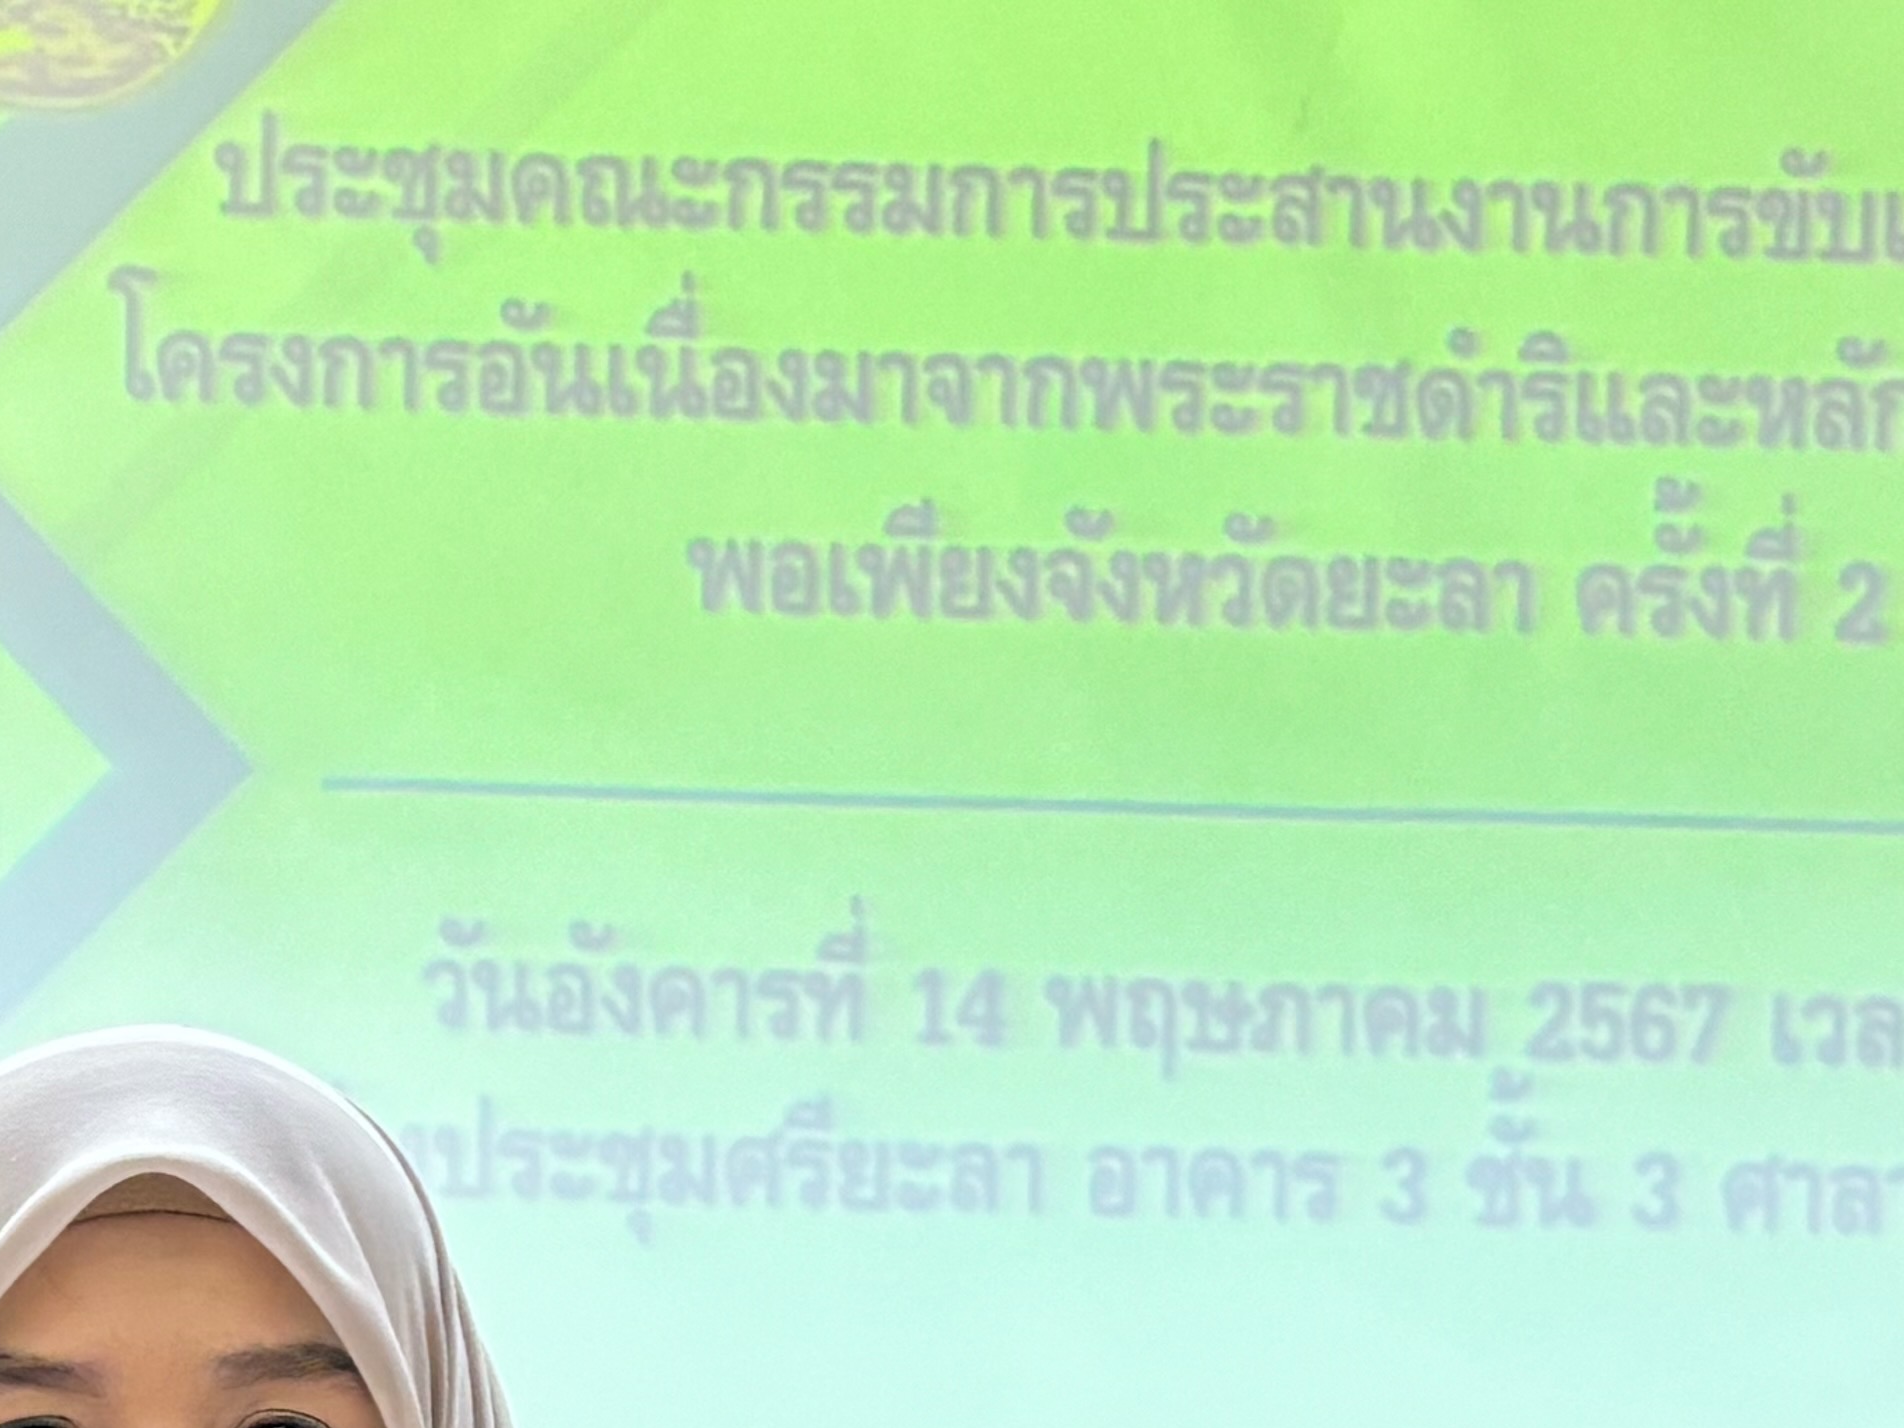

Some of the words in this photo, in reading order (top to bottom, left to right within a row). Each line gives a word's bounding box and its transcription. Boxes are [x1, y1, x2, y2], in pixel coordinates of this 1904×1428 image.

[686, 497, 1537, 636] พอเพียงจังหวัดยะลา
[1575, 475, 1800, 643] ครั้งที่
[1834, 560, 1892, 646] 2
[423, 895, 869, 1041] วันอังคารที่
[915, 968, 1007, 1048] 14
[1045, 975, 1486, 1080] พฤษภาคม
[1526, 981, 1734, 1063] 2567
[399, 1094, 1044, 1244] งประชุมศรียะลา
[1091, 1146, 1339, 1221] อาคาร
[1382, 1147, 1427, 1224] 3
[1466, 1066, 1597, 1229] ชั้น
[1633, 1153, 1680, 1229] 3
